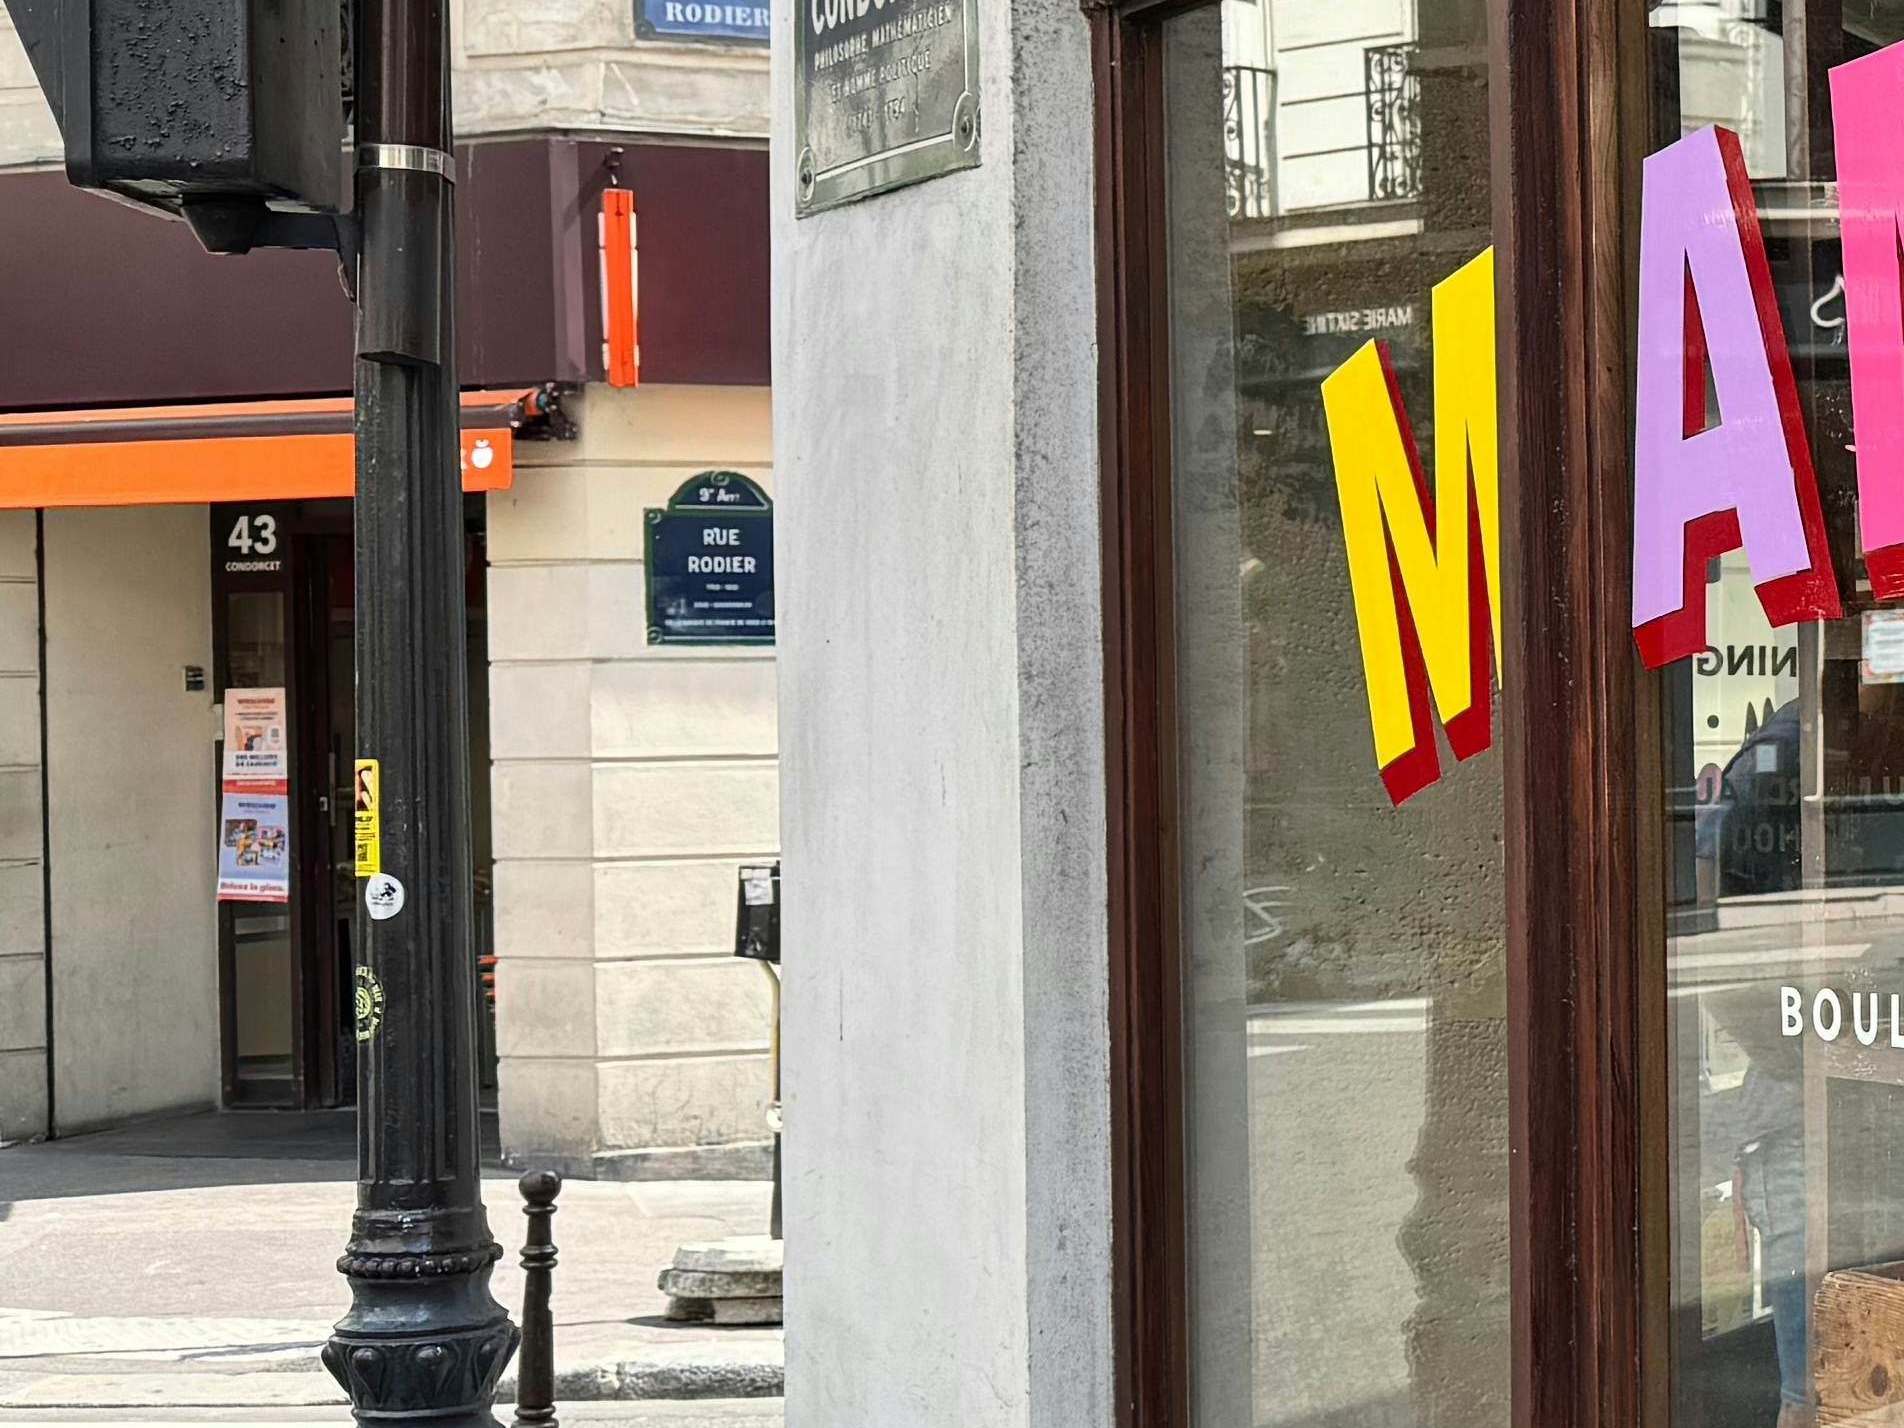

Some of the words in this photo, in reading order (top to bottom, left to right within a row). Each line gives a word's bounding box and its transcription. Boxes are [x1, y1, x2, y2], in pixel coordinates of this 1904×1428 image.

[665, 2, 769, 27] RODIER
[228, 514, 277, 555] 43
[703, 527, 741, 546] RUE
[225, 560, 281, 572] CONDORCET
[688, 555, 757, 574] RODIER
